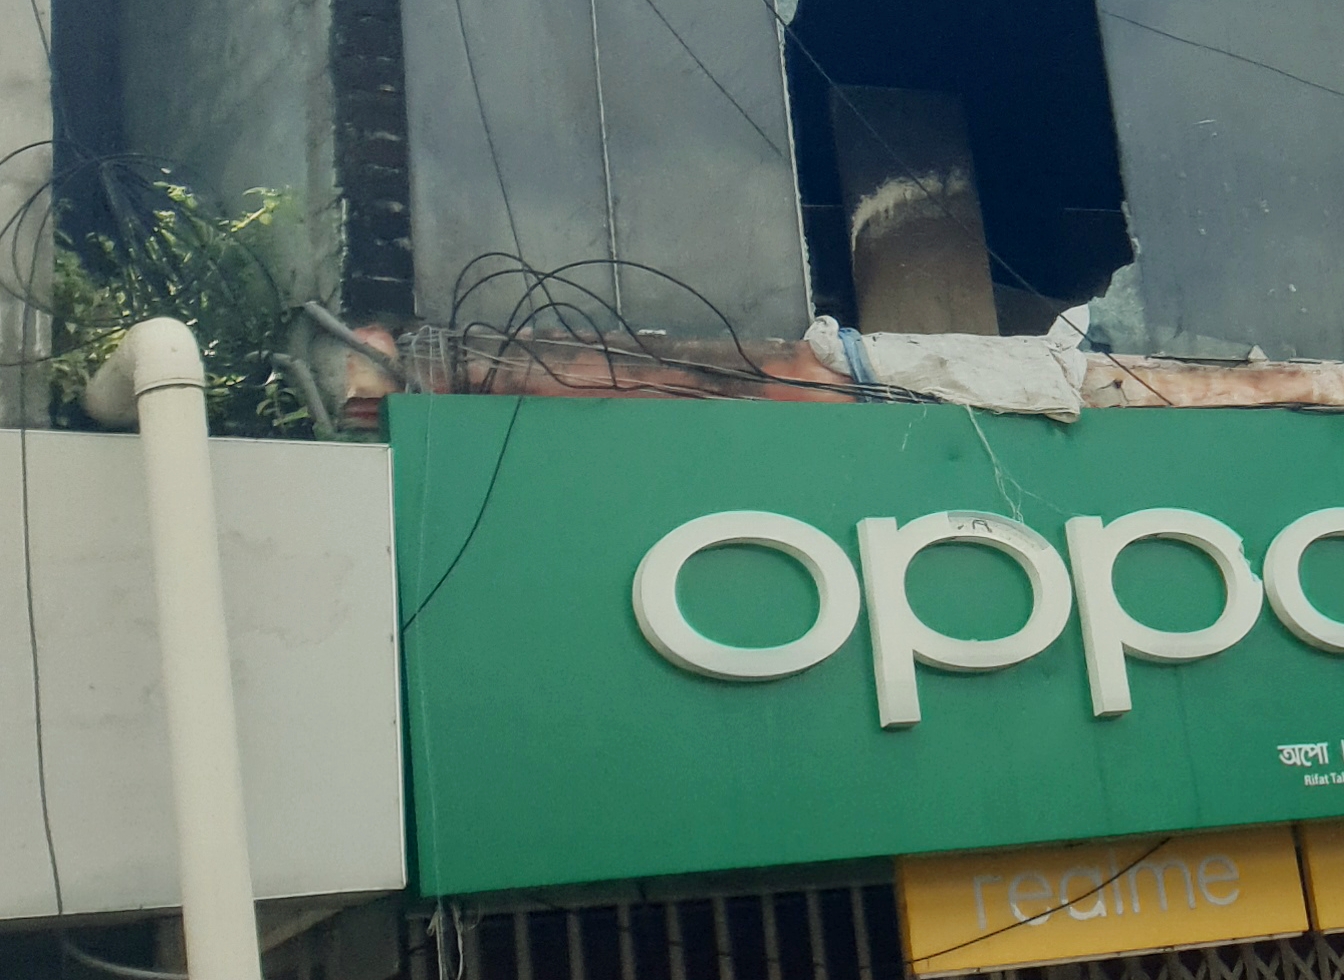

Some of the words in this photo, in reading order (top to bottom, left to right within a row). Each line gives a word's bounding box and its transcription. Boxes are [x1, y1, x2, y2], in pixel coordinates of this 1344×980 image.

[1277, 741, 1330, 767] অপো
[1304, 771, 1330, 787] Rifat
[972, 846, 1241, 931] realme
